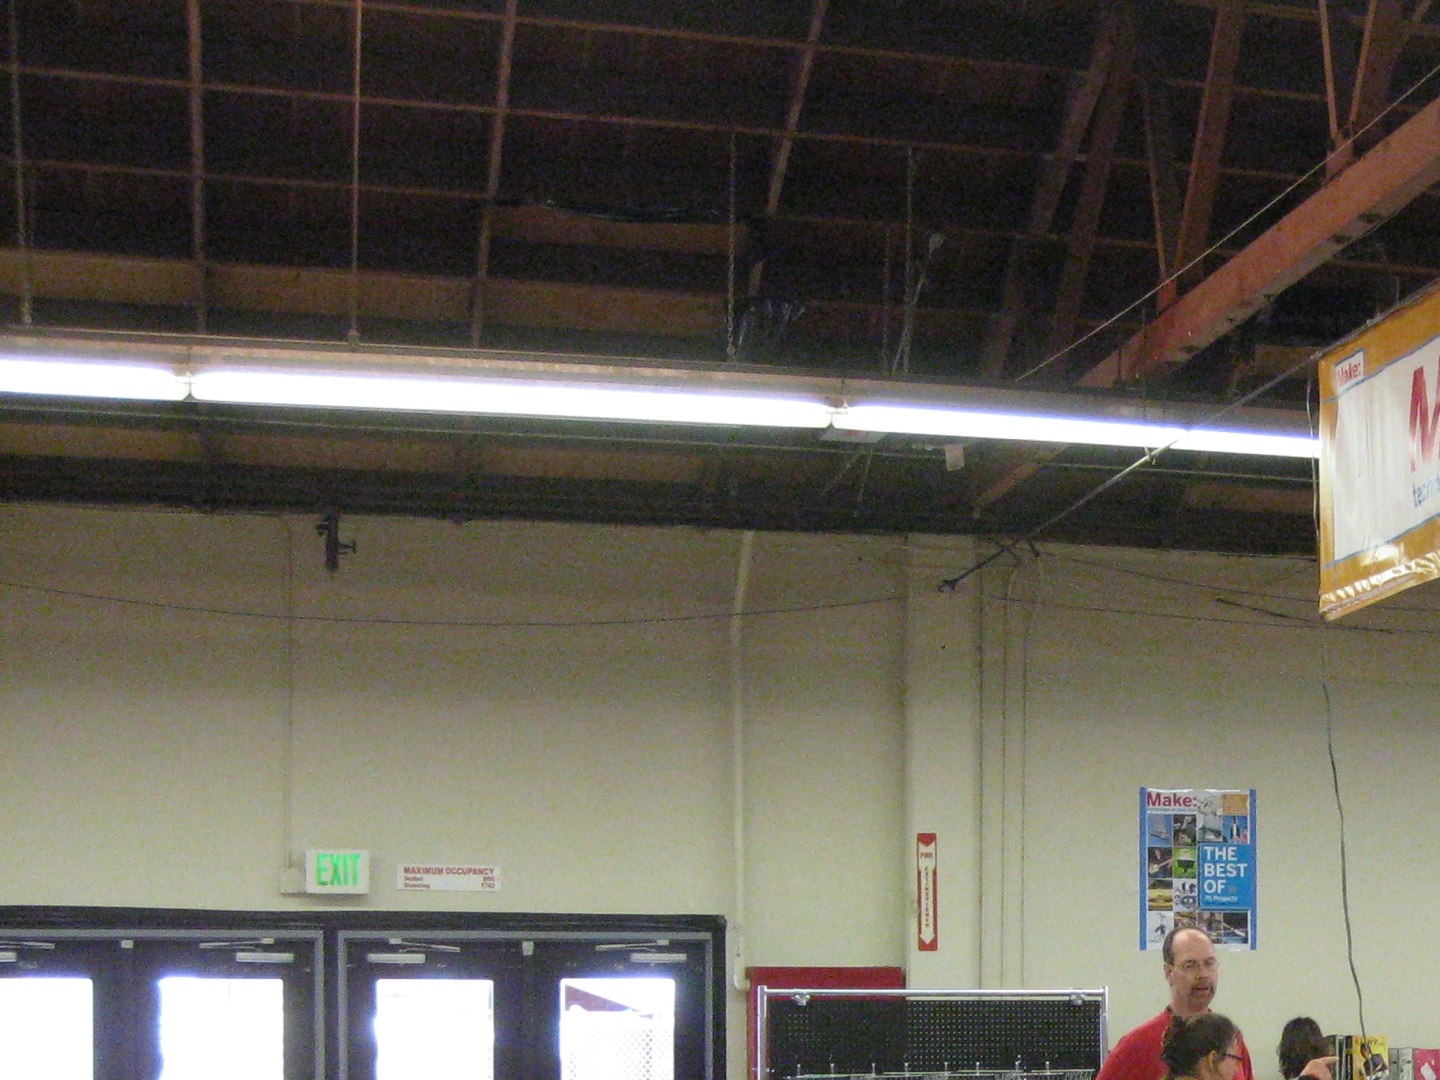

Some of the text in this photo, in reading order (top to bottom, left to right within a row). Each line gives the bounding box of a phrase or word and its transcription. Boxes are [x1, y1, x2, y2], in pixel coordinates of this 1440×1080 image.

[1146, 791, 1198, 808] Make:
[1203, 846, 1238, 861] THE
[316, 853, 361, 887] EXIT
[403, 866, 495, 876] MAXIMUM OCCUPANCY
[1203, 863, 1248, 877] BEST
[1203, 879, 1227, 894] OF
